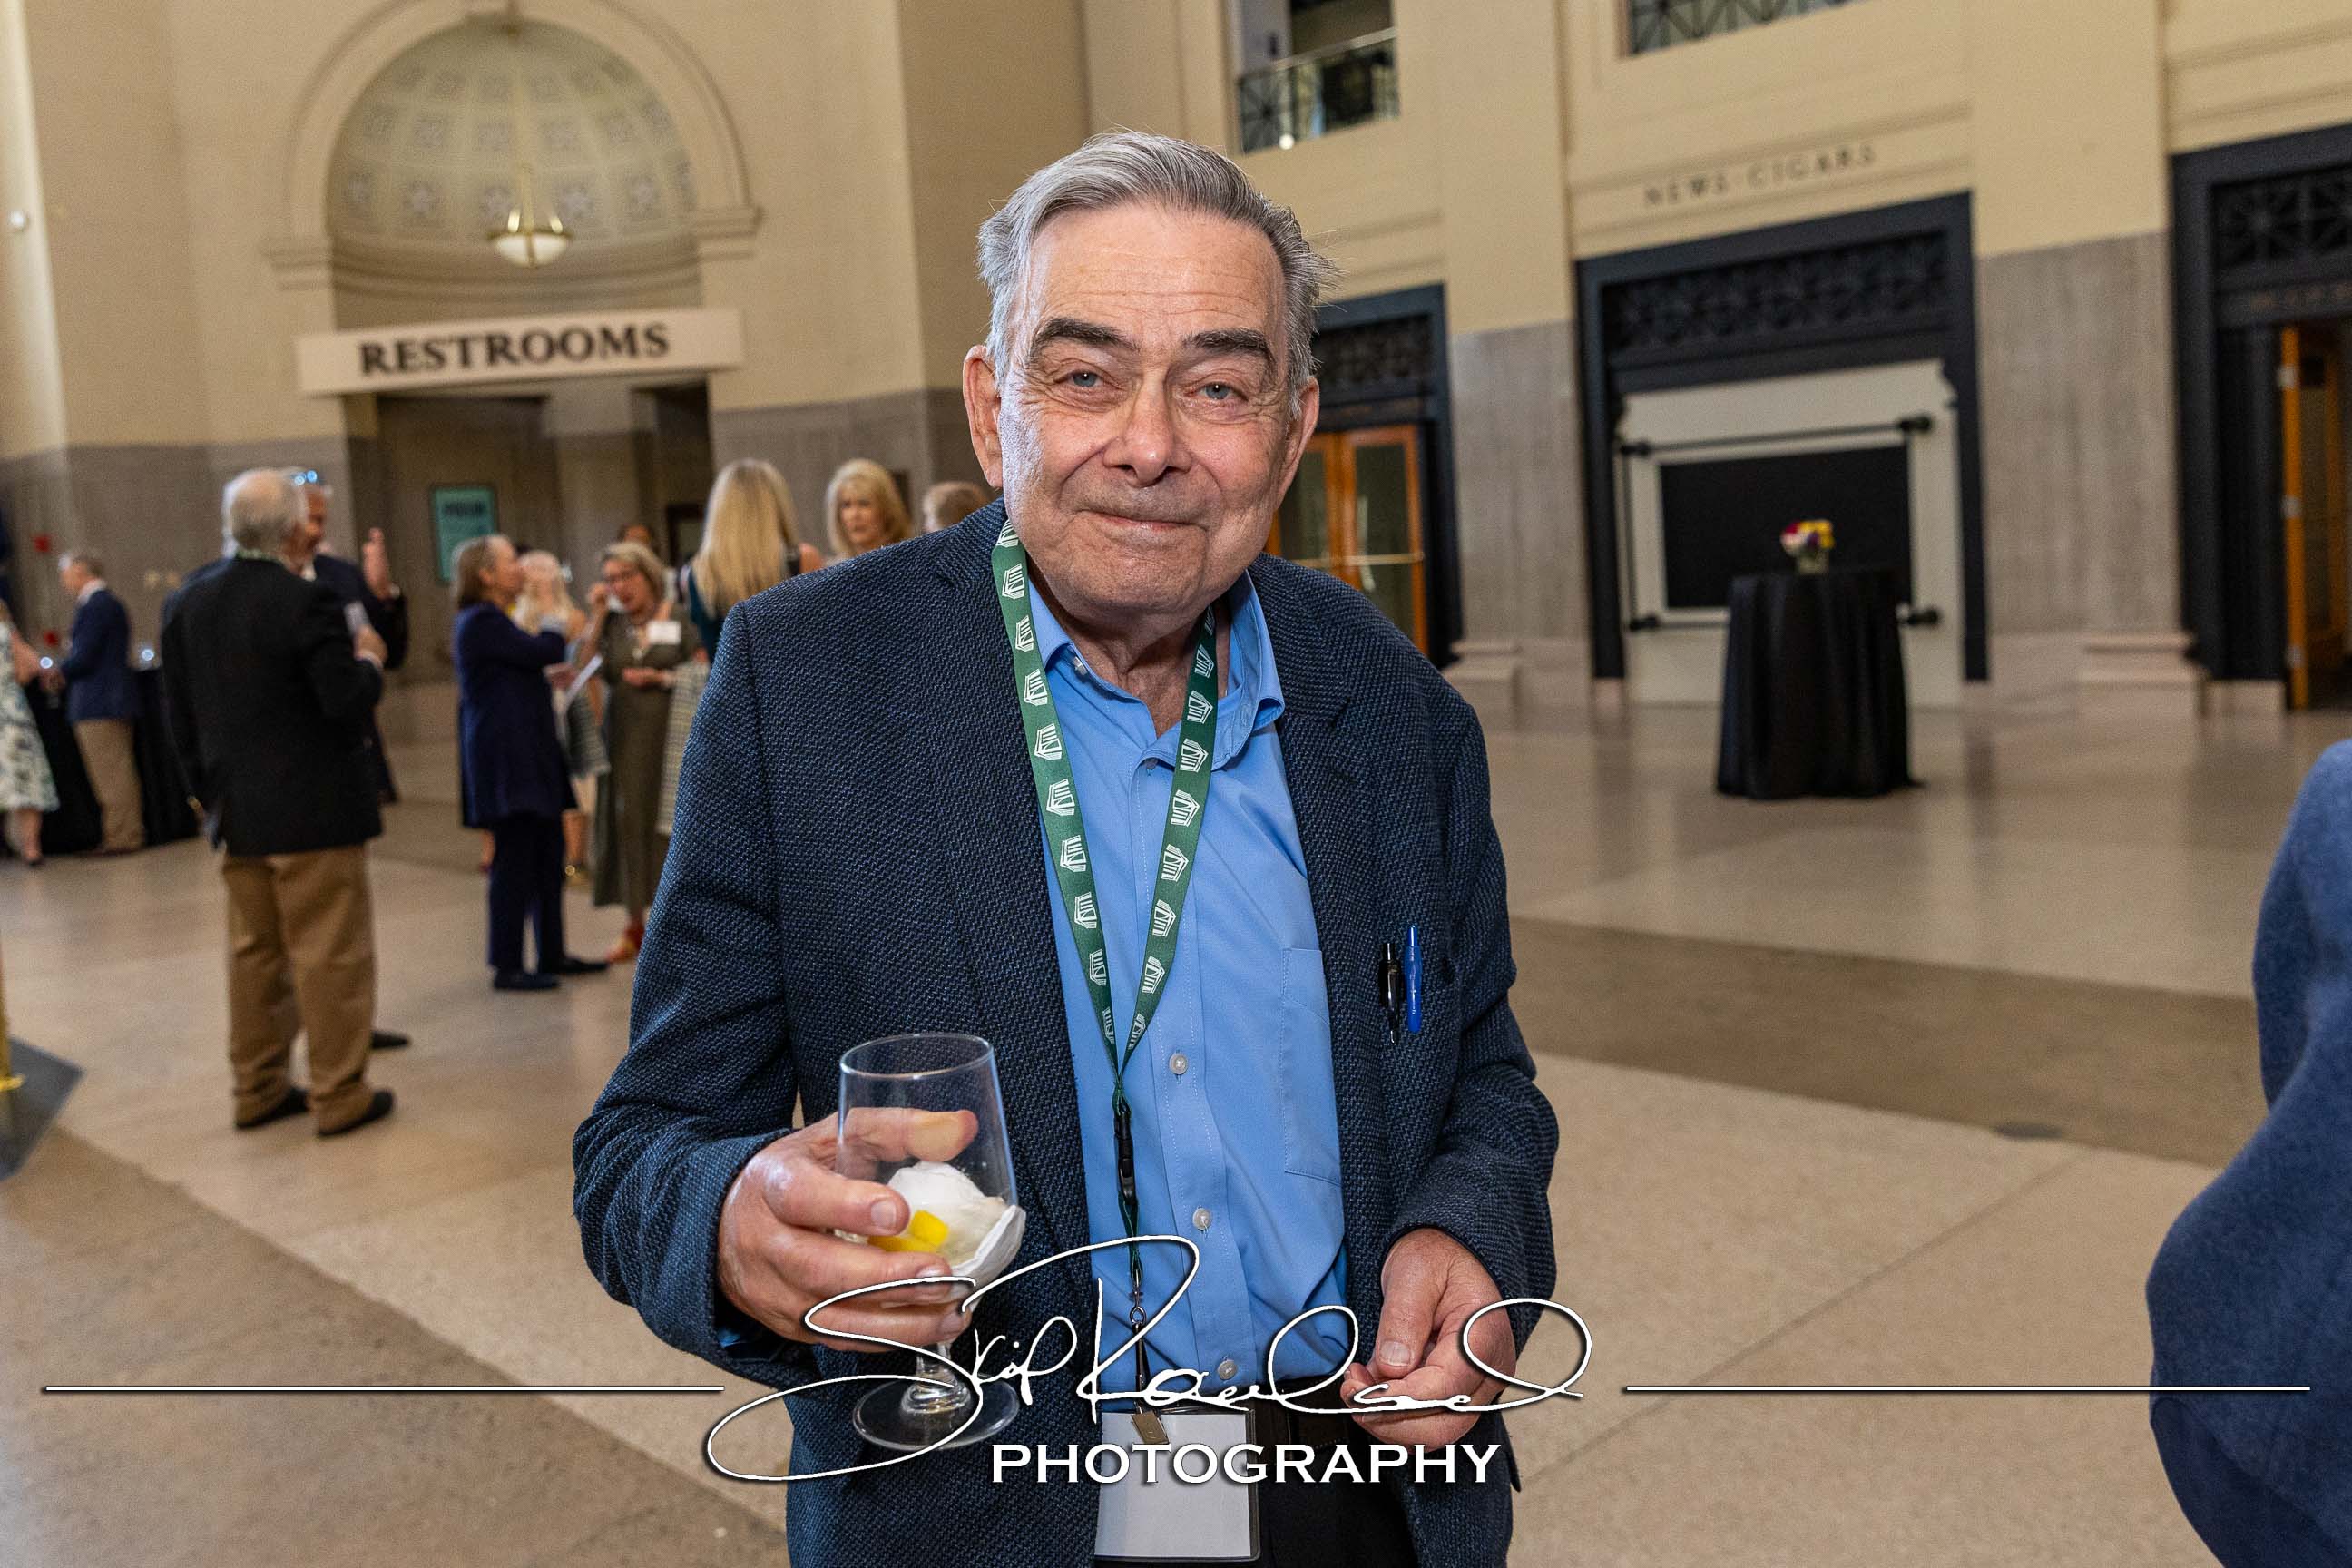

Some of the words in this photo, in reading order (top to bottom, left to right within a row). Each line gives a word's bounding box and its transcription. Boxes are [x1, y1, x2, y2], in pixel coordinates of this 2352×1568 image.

[1643, 172, 1727, 204] NEWS
[1746, 144, 1876, 188] CIGARS
[359, 321, 670, 376] RESTROOMS
